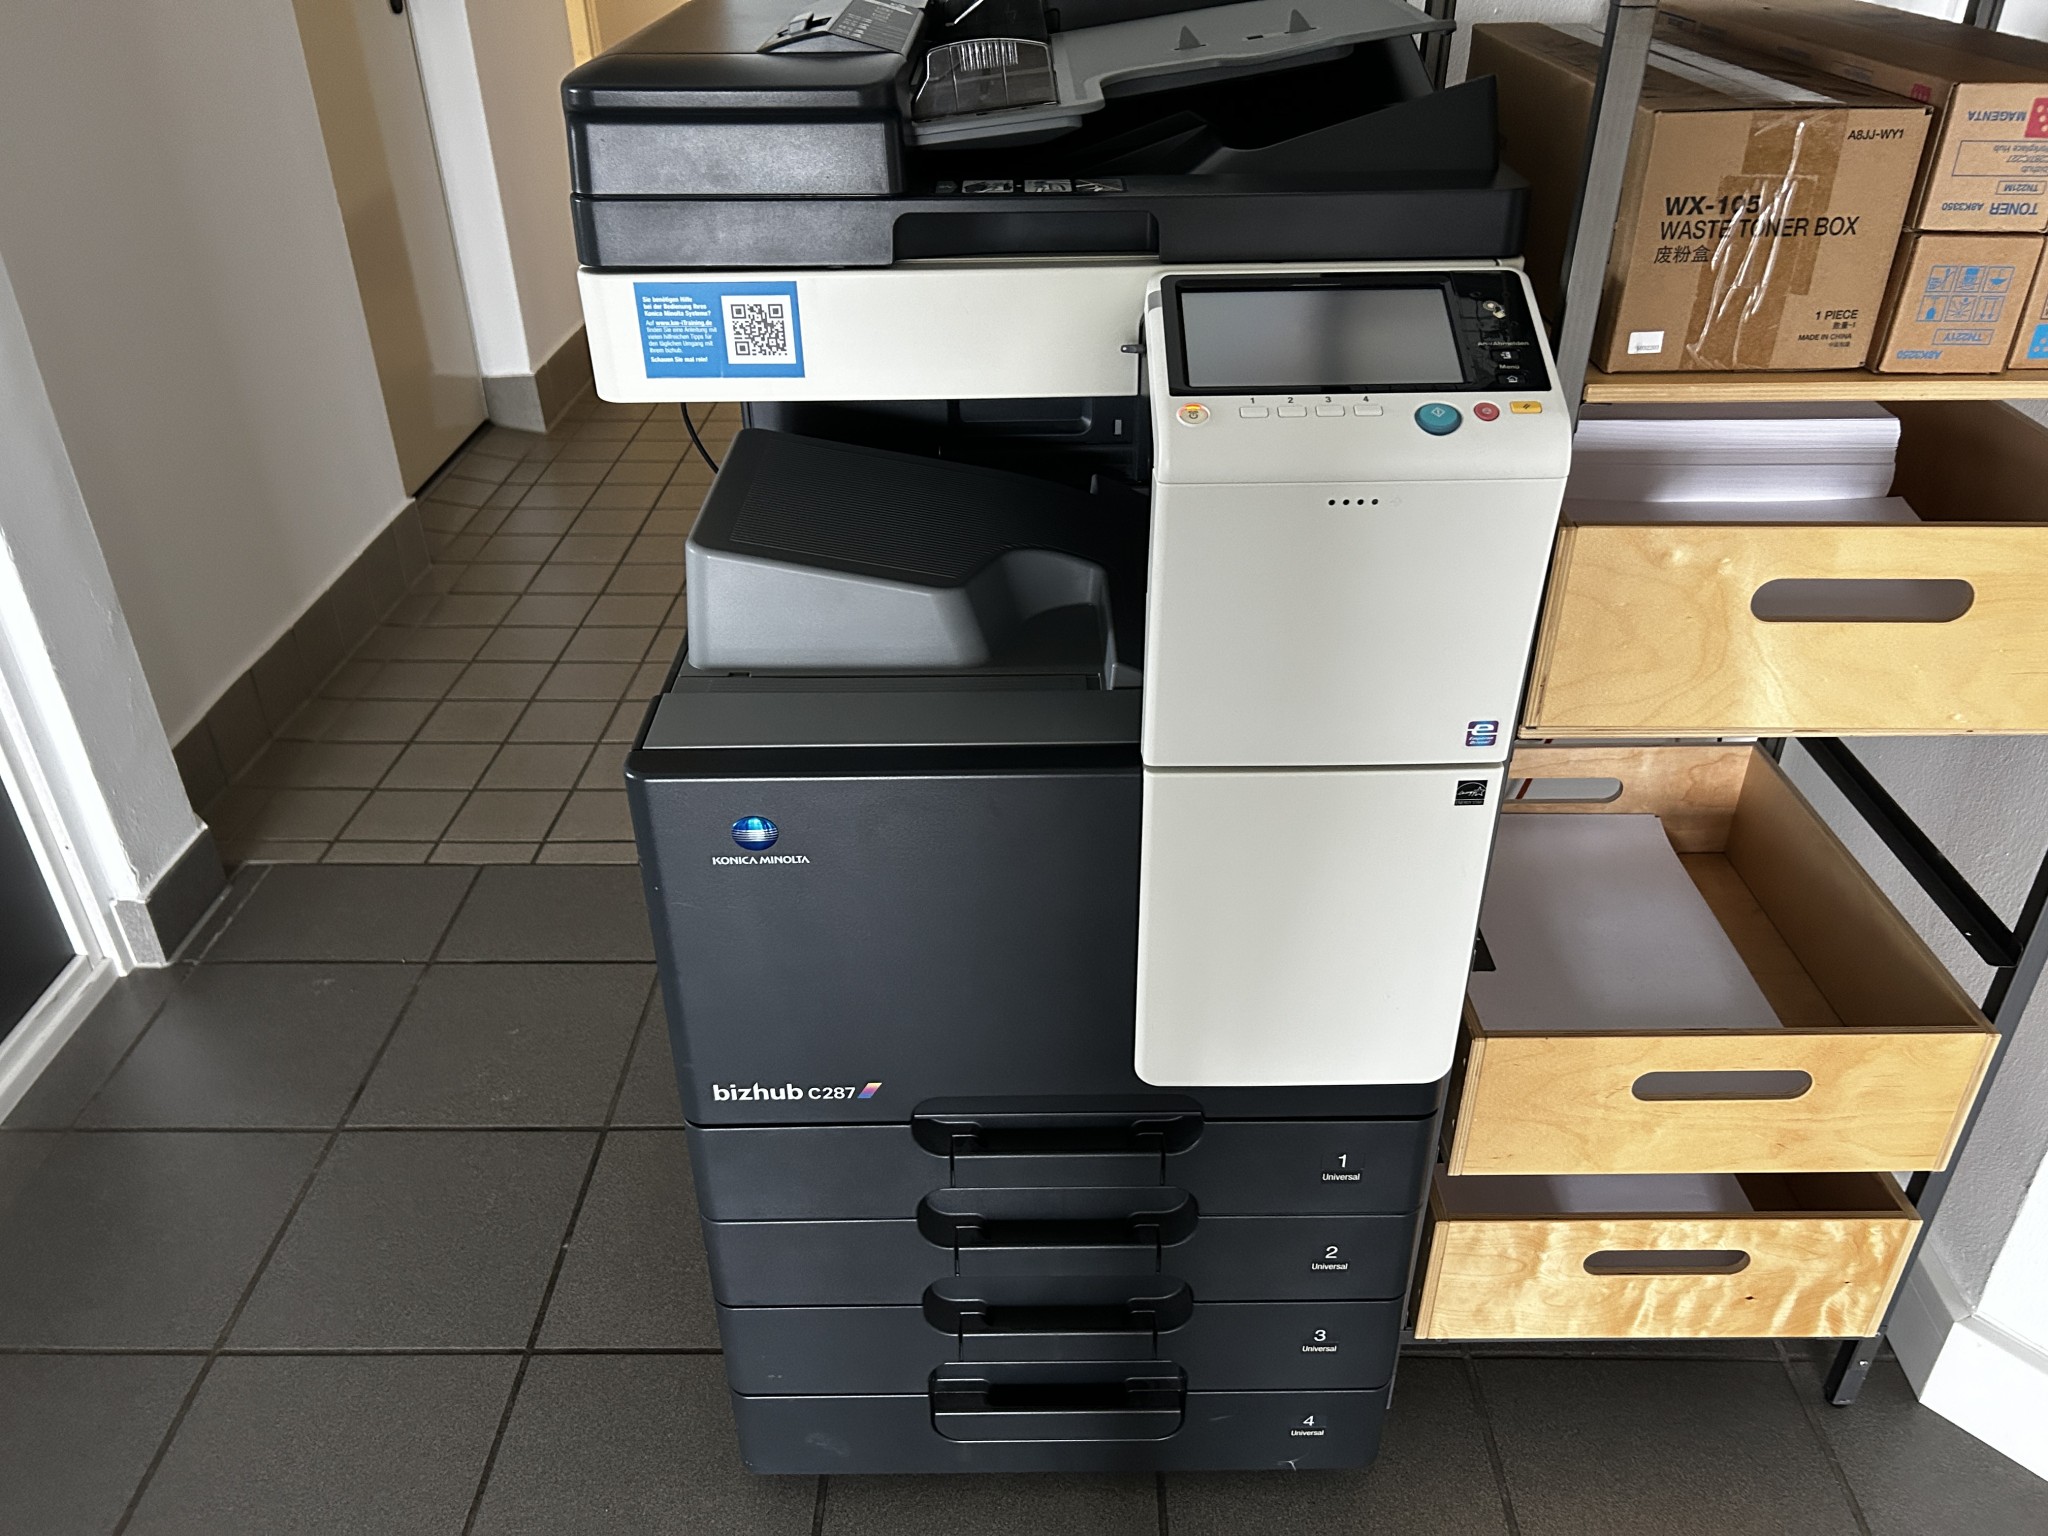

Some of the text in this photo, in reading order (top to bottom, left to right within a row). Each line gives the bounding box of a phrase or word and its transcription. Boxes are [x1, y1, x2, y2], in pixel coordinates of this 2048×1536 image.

[1968, 111, 2026, 121] MAGENTA
[1848, 129, 1904, 140] A8JJ-WY1
[1993, 144, 2011, 152] Hub
[2003, 184, 2038, 192] TN221M
[1665, 195, 1761, 216] WX-105
[1942, 202, 2038, 215] TONER A8K3350
[1660, 216, 1860, 240] WASTE TONER BOX
[1653, 244, 1711, 264] 废粉盒
[1816, 309, 1859, 320] 1 PIECE
[1943, 333, 1983, 342] TN221Y
[712, 855, 810, 865] KONICA MINOLTA
[712, 1082, 856, 1101] bizhub C287
[1338, 1154, 1347, 1168] 1
[1322, 1172, 1361, 1181] Universal
[1325, 1245, 1338, 1259] 2
[1311, 1262, 1348, 1271] Universal
[1313, 1329, 1326, 1342] 3
[1302, 1345, 1337, 1353] Universal
[1303, 1415, 1315, 1427] 4
[1290, 1429, 1325, 1437] Universal
